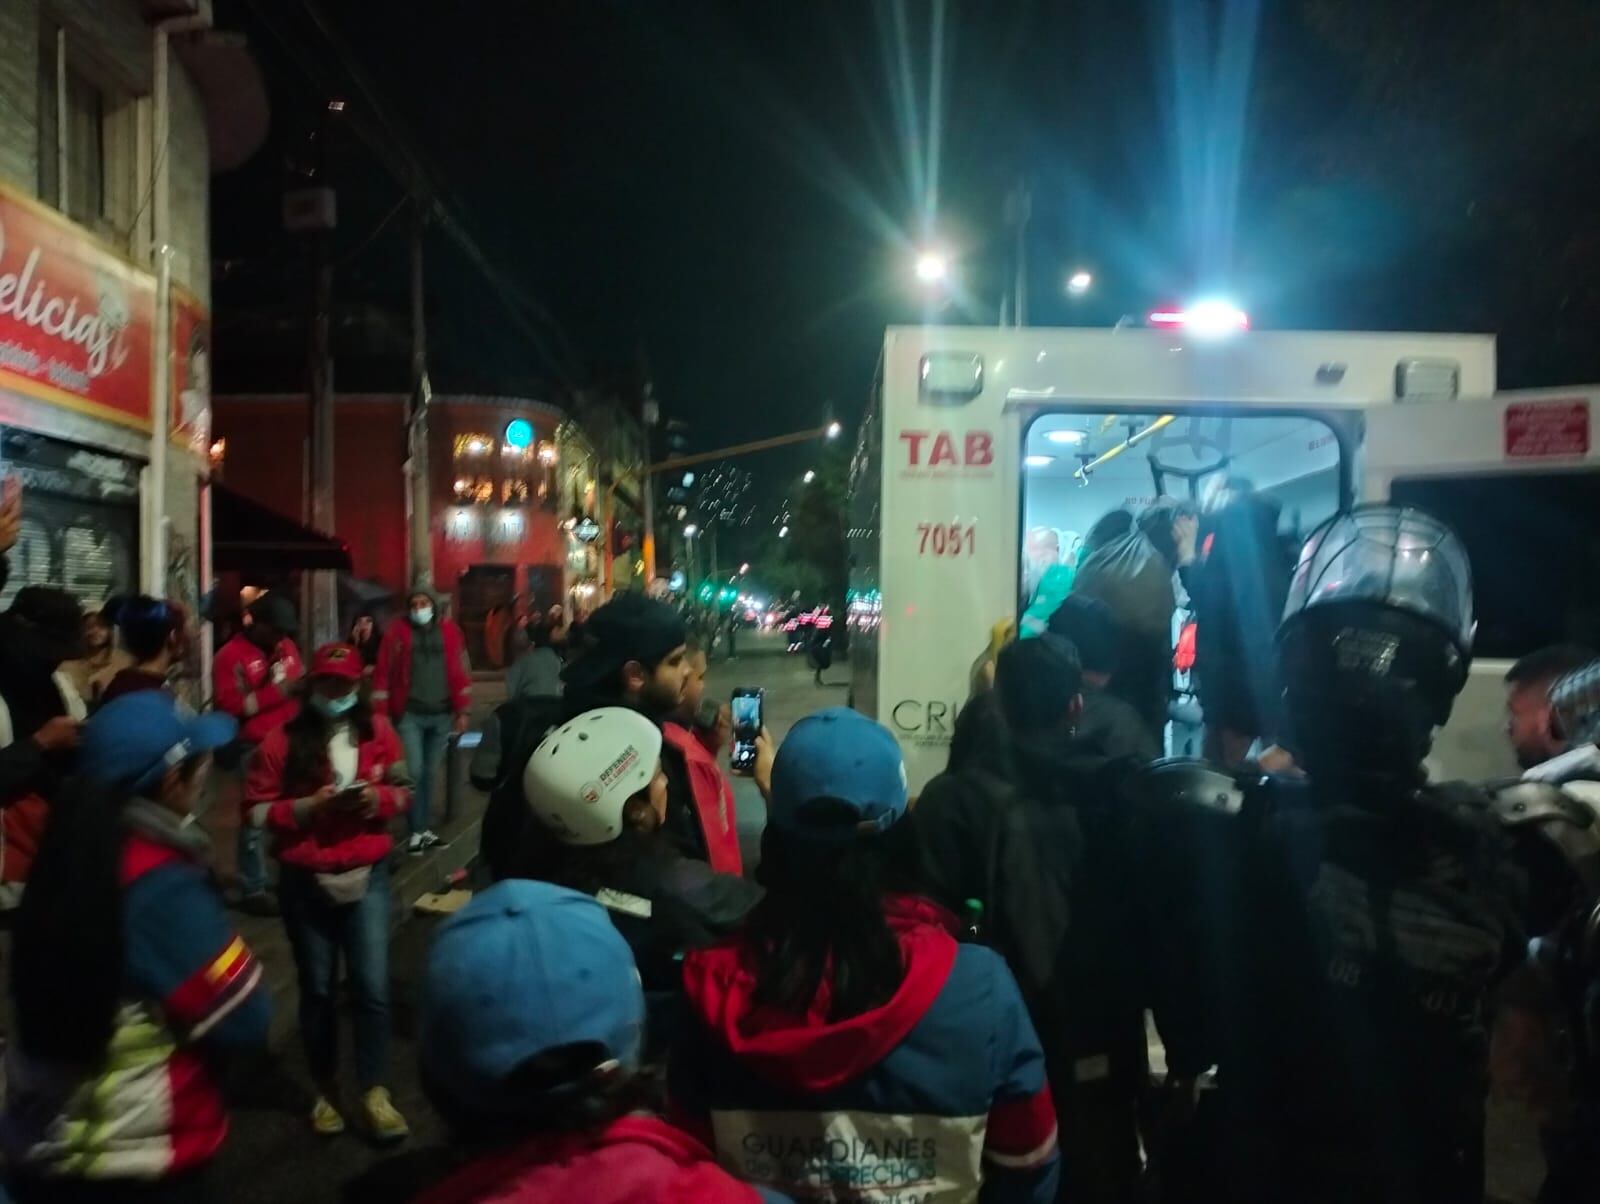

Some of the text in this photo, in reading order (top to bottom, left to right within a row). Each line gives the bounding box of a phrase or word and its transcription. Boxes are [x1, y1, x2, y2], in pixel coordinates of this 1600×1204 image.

[0, 222, 119, 379] elicias
[898, 430, 994, 466] TAB
[917, 524, 976, 556] 7051
[742, 1132, 938, 1163] GUARDIANES
[819, 1158, 937, 1186] DERECHOS
